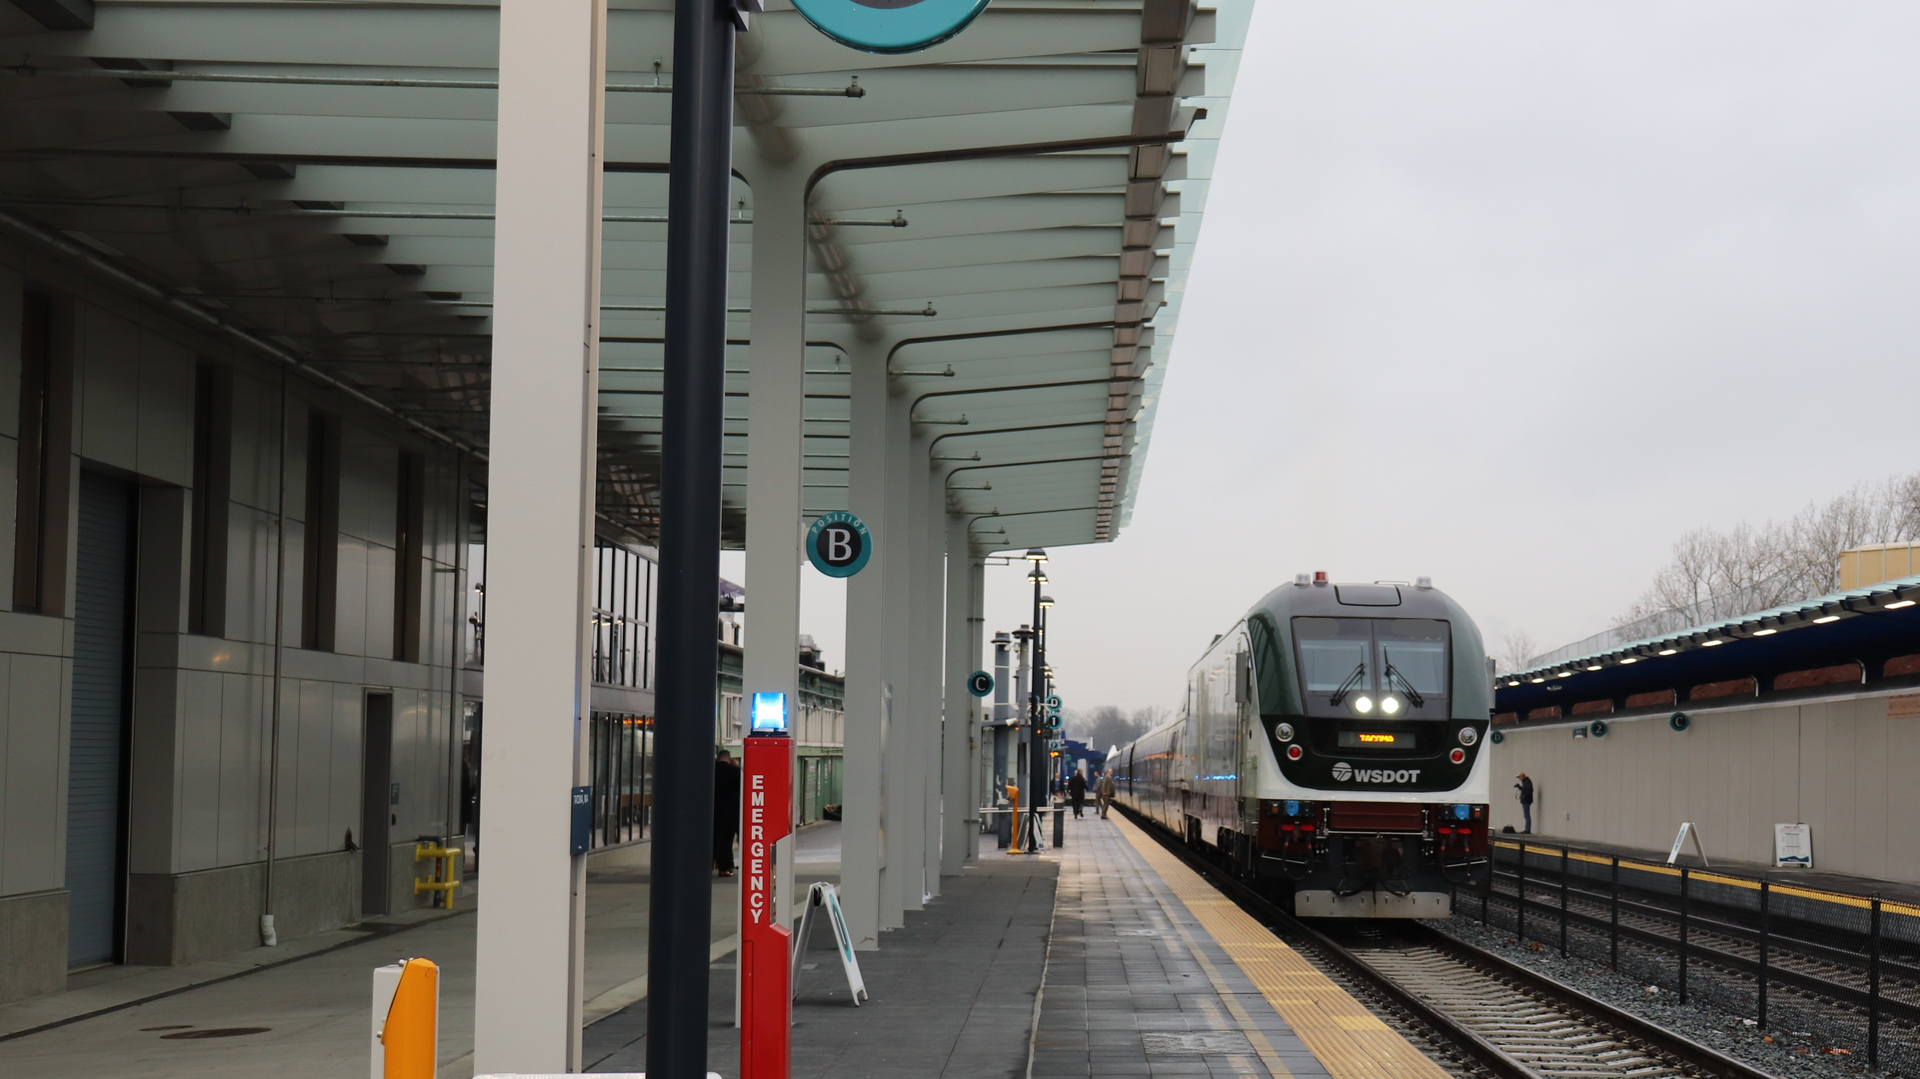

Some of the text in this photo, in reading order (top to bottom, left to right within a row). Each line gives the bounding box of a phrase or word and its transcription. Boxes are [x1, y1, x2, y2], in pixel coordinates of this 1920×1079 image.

[811, 513, 868, 535] POSITION
[826, 528, 852, 561] B
[975, 676, 987, 691] C
[1051, 698, 1058, 707] D
[1675, 716, 1683, 727] C
[1595, 724, 1602, 734] 2
[1354, 769, 1421, 783] WSDOT
[750, 774, 765, 924] EMERGENCY
